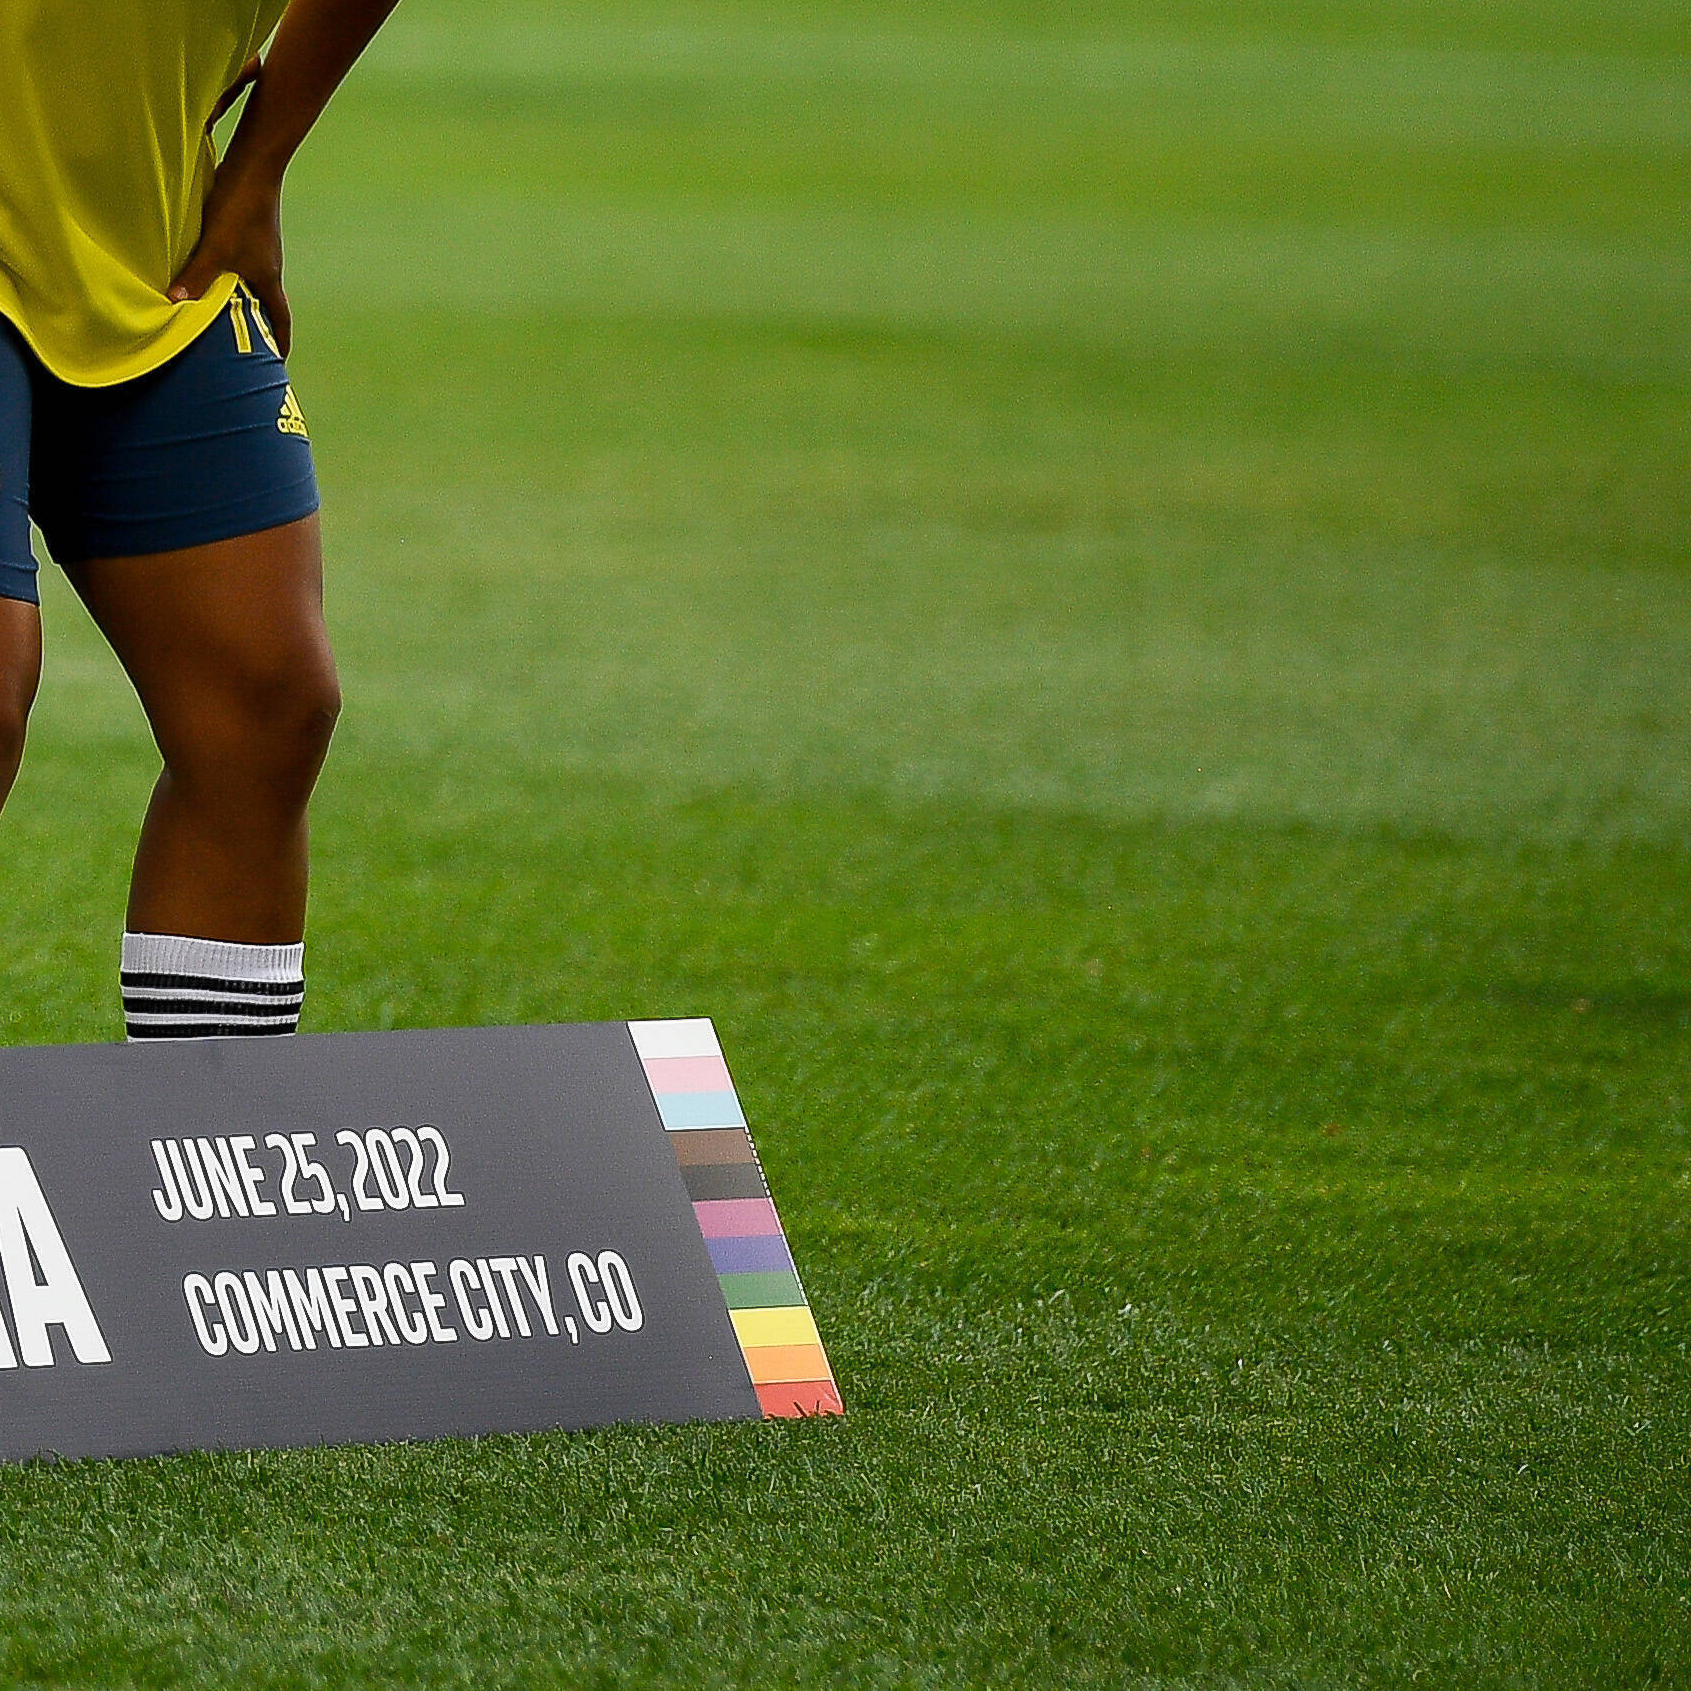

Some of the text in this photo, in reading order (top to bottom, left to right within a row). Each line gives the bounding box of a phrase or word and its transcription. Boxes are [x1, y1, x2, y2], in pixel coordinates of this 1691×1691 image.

[151, 1136, 277, 1221] JUNE
[183, 1261, 457, 1356] COMMERCE
[566, 1250, 645, 1334] CO
